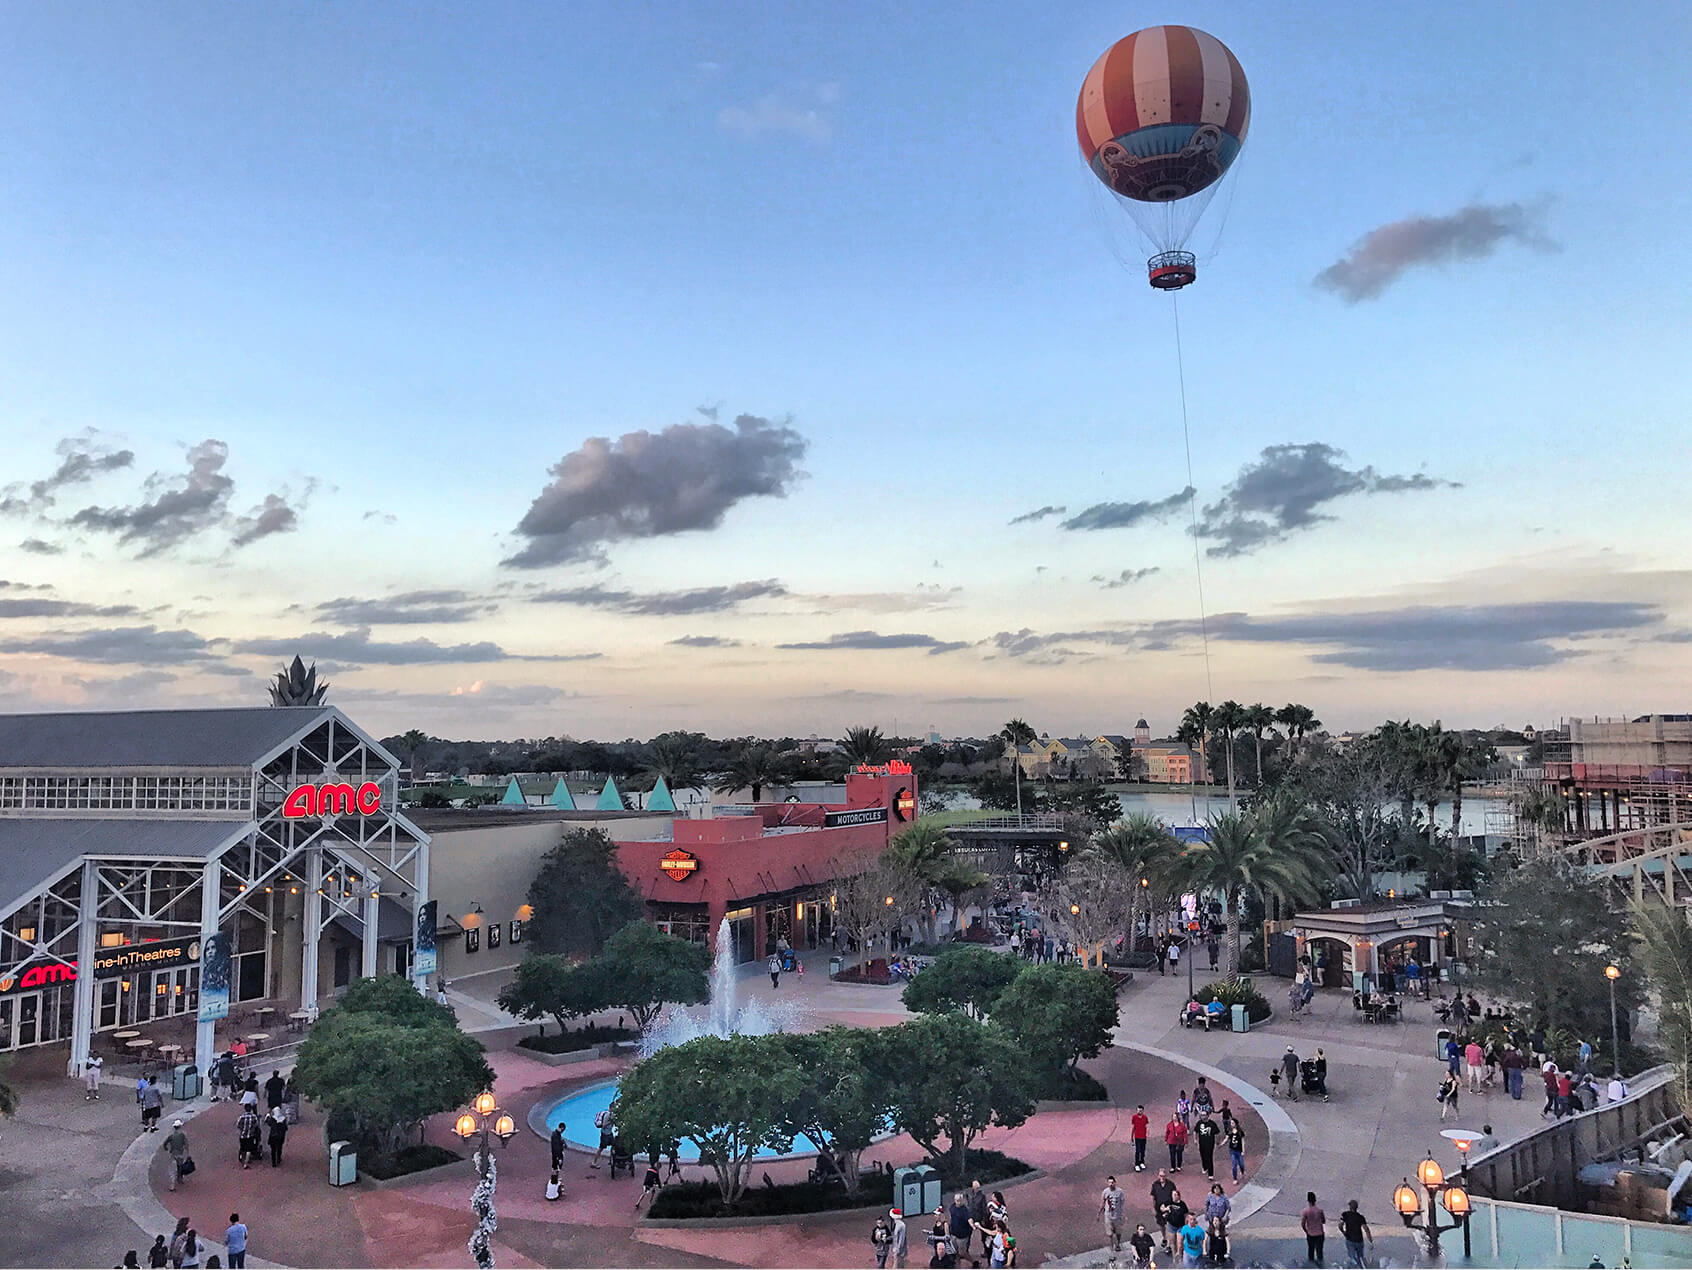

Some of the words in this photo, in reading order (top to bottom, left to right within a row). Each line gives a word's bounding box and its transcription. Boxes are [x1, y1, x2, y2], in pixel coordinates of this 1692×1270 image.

[282, 781, 381, 818] amc
[837, 811, 881, 825] MOTORCYCLES
[94, 955, 128, 969] ine-In
